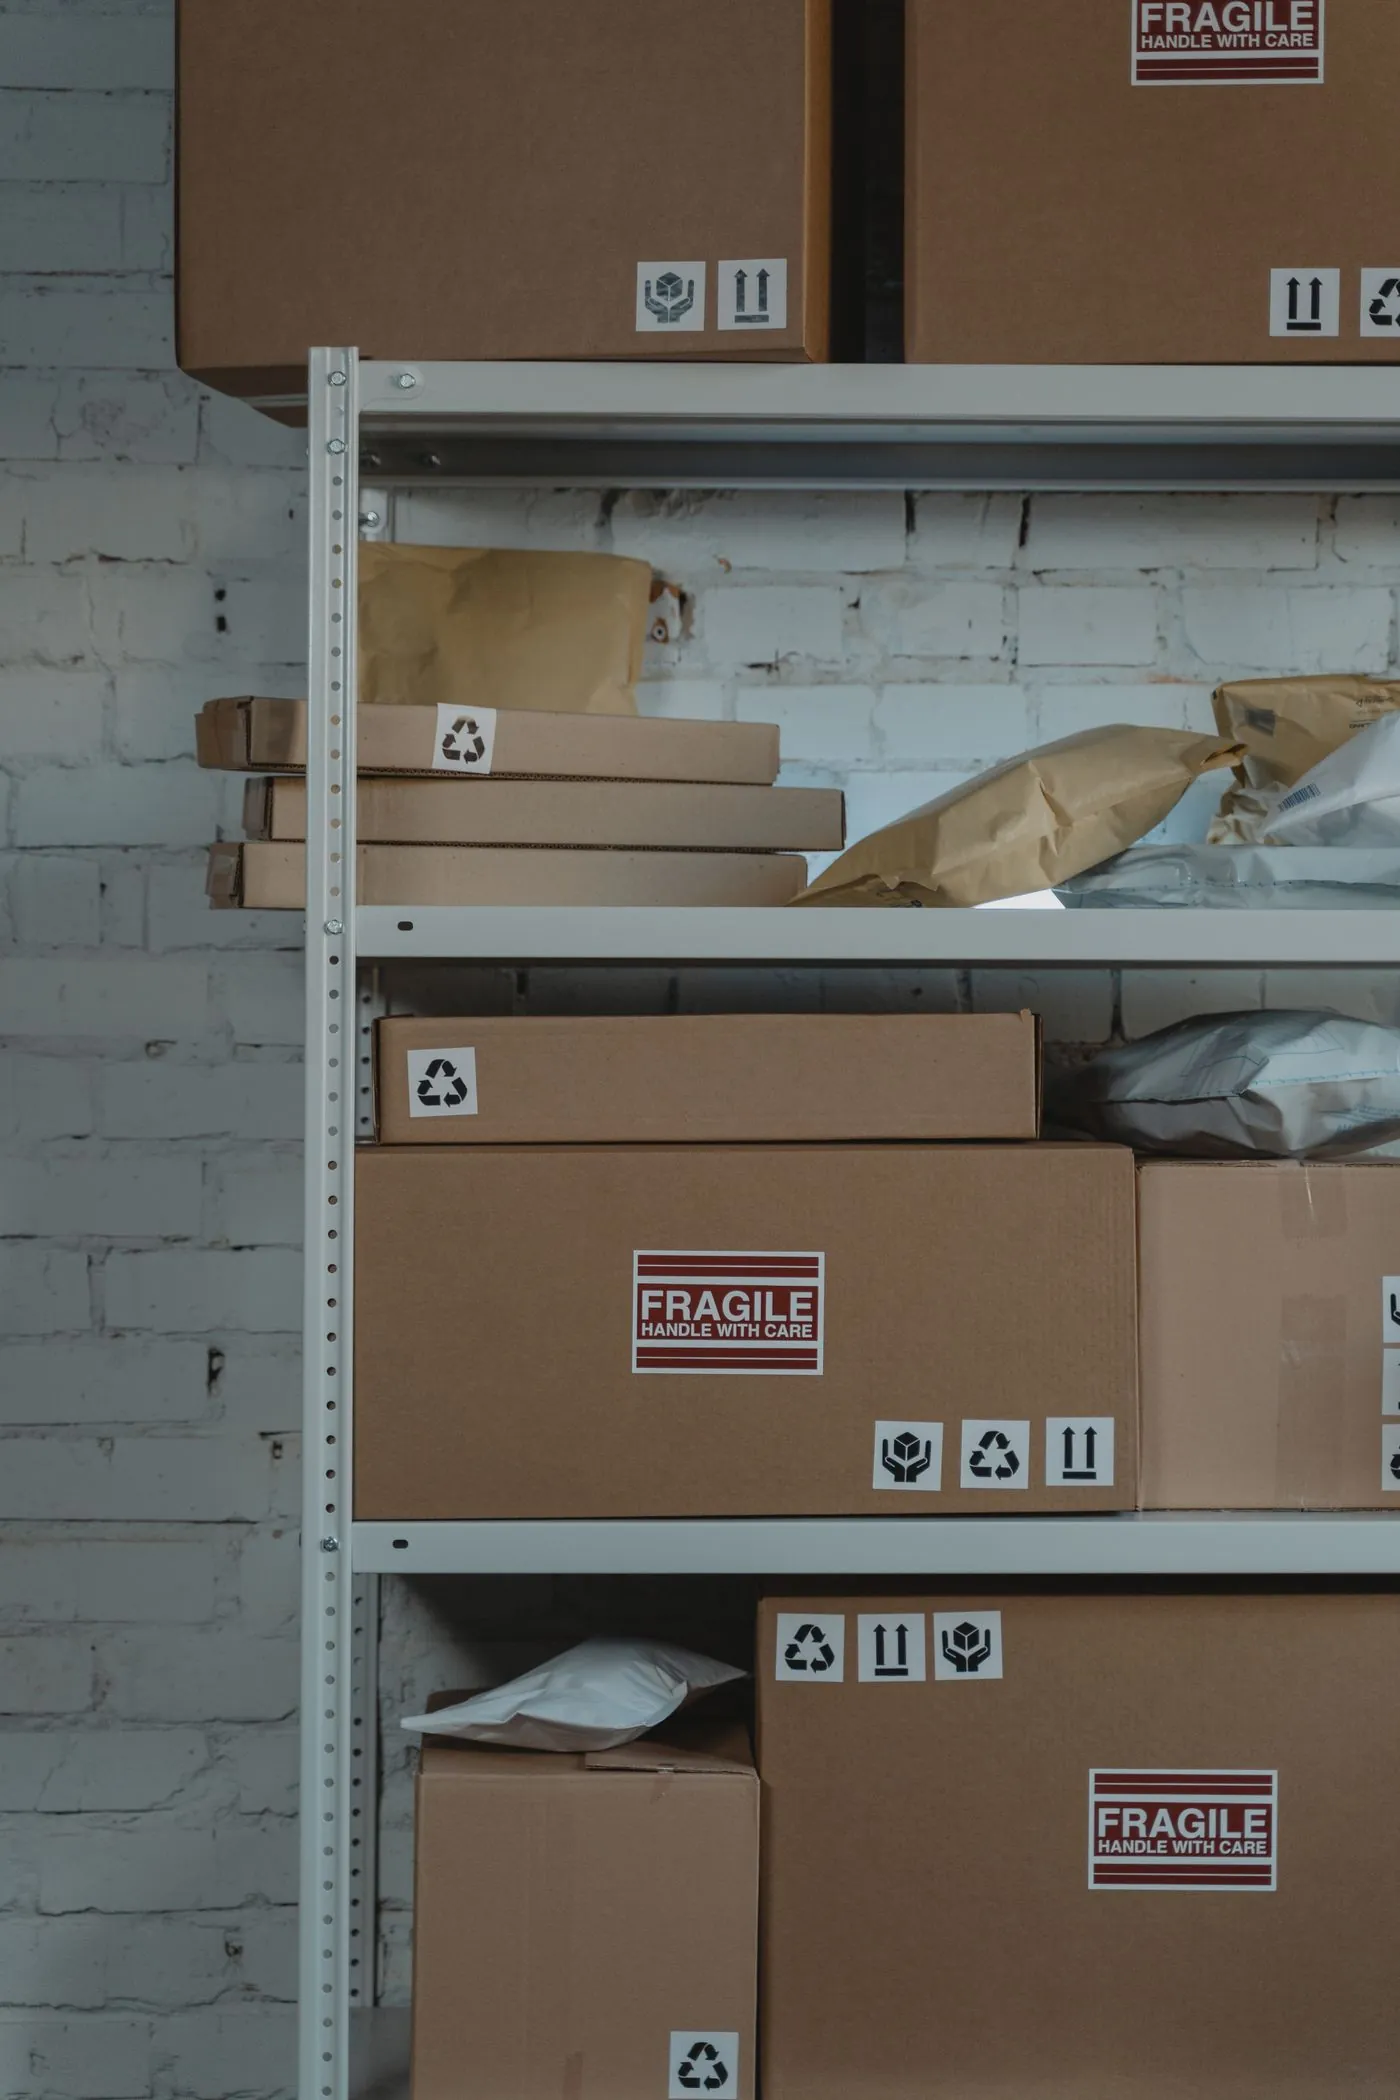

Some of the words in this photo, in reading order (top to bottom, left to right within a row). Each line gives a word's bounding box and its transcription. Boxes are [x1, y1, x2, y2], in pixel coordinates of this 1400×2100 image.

[1141, 1, 1314, 33] FRAGILE
[1141, 34, 1212, 49] HANDLE
[1217, 33, 1261, 48] WITH
[1265, 32, 1314, 47] CARE
[641, 1289, 814, 1321] FRAGILE
[641, 1323, 712, 1337] HANDLE
[717, 1323, 760, 1338] WITH
[765, 1324, 814, 1339] CARE
[1097, 1807, 1268, 1838] FRAGILE
[1098, 1840, 1168, 1854] HANDLE
[1172, 1840, 1214, 1854] WITH
[1219, 1840, 1267, 1854] CARE
